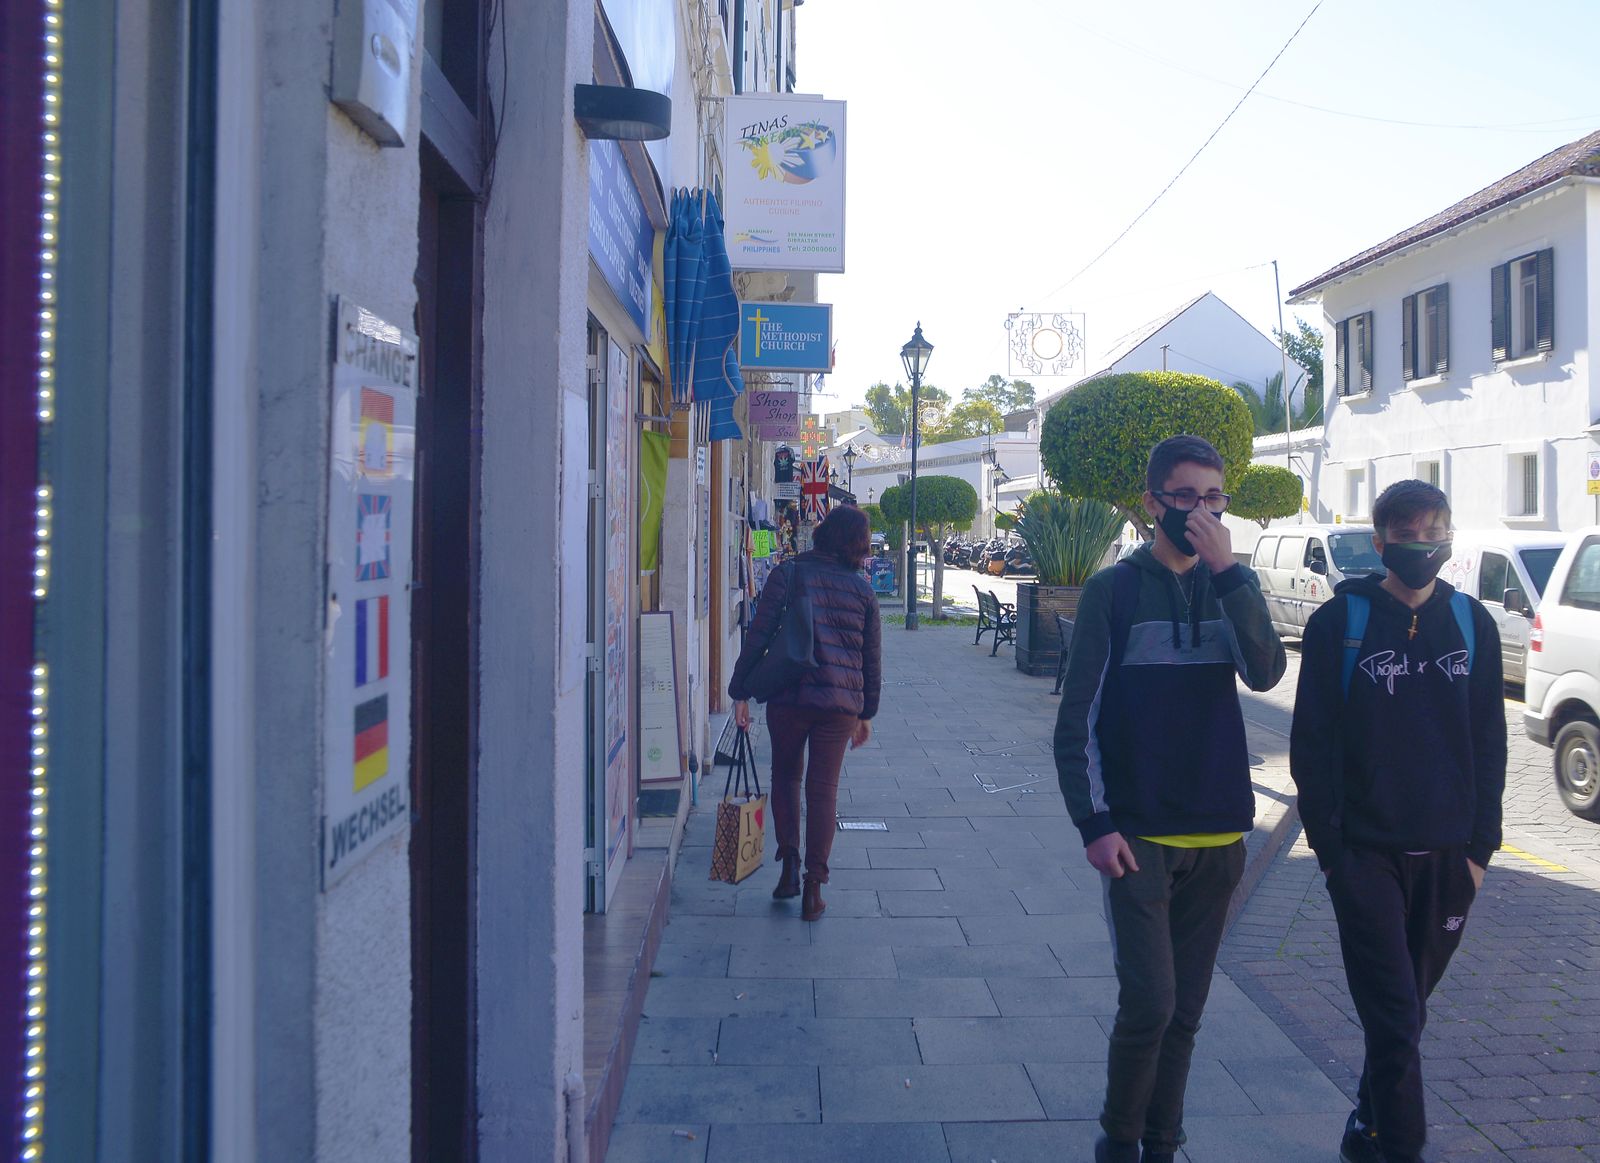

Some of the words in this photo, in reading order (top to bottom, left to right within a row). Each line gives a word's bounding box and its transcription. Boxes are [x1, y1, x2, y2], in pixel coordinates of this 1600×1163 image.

[740, 114, 789, 139] TINAS
[790, 199, 823, 208] FILIPINO
[742, 245, 781, 253] PHILIPPINES
[760, 322, 783, 332] THE
[760, 331, 823, 342] METHODIST
[760, 340, 805, 351] CHURCH
[751, 392, 787, 407] Shoe
[765, 407, 797, 423] Shop
[1359, 649, 1410, 695] Project
[331, 783, 406, 865] WECHSEL
[745, 811, 751, 837] I
